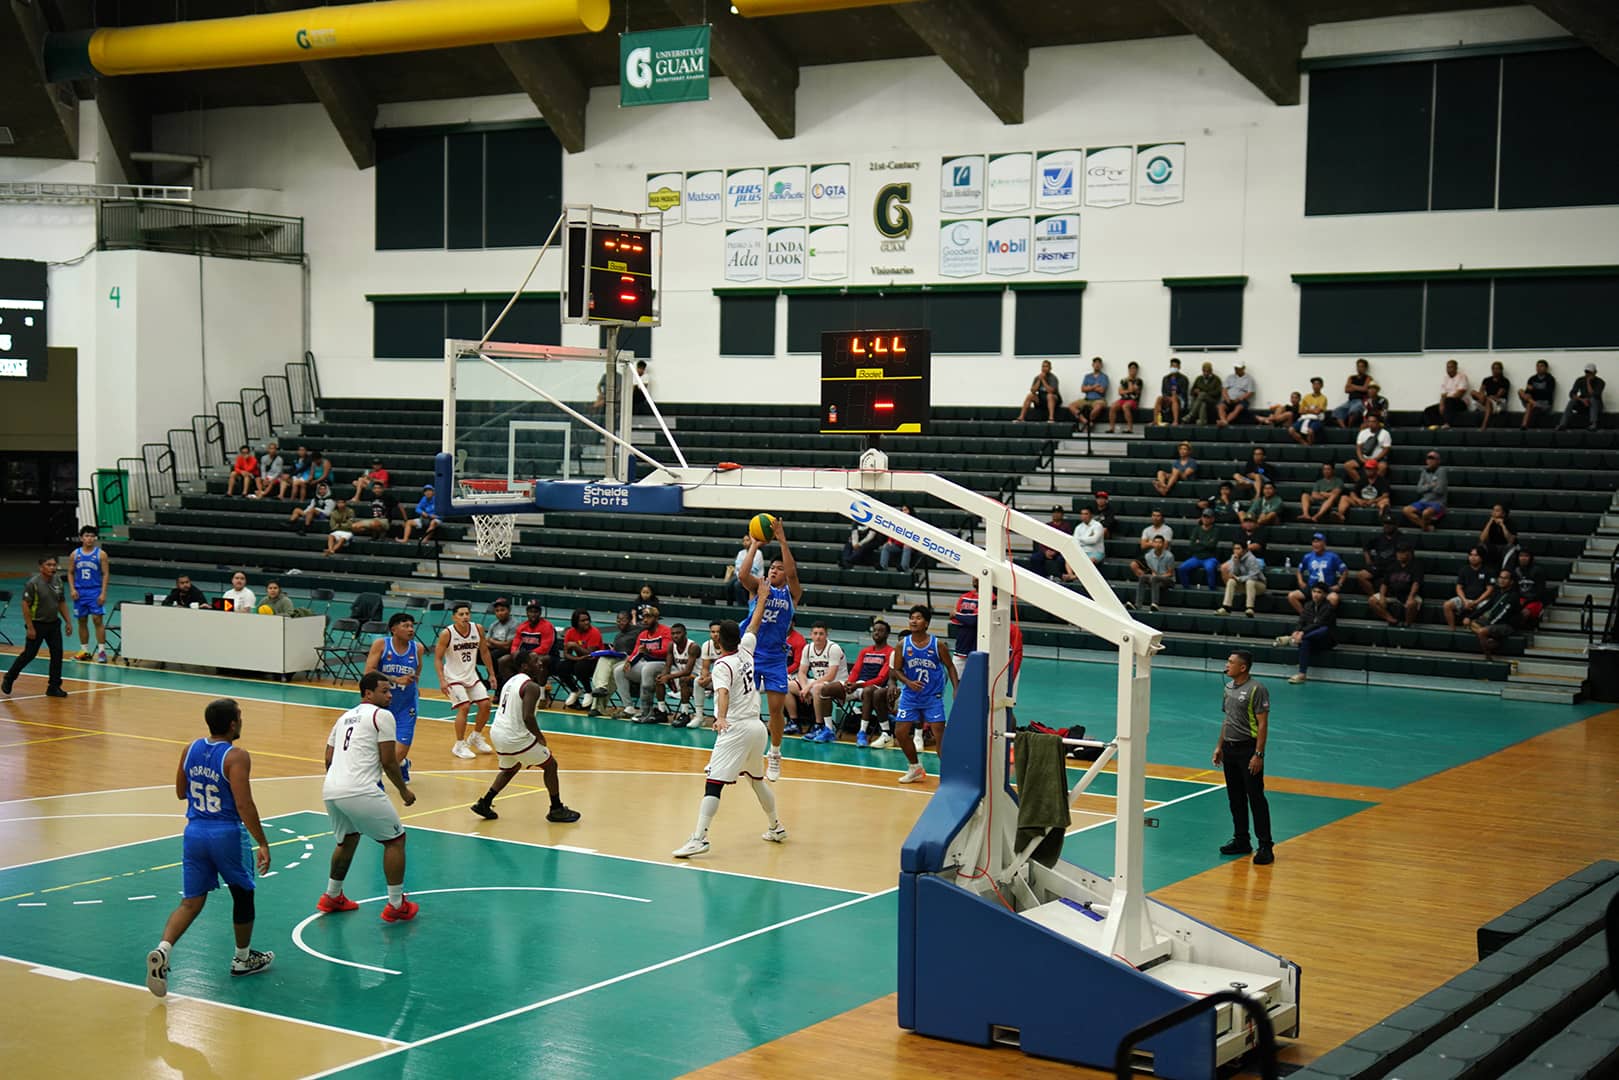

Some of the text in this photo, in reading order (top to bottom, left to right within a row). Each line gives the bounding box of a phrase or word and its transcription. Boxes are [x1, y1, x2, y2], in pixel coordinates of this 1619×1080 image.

[656, 49, 693, 58] UNIVERSITY
[656, 56, 704, 75] GUAM
[687, 192, 720, 200] Matson
[825, 185, 846, 196] GTA
[768, 242, 804, 252] LINDA
[988, 240, 1026, 253] Mobil
[728, 249, 759, 266] Ada
[769, 254, 802, 264] LOOK
[871, 267, 914, 275] Visionaries
[109, 286, 120, 308] 4
[583, 485, 629, 497] Schelde
[583, 494, 629, 507] Sports
[874, 514, 920, 543] Schelde
[921, 536, 961, 562] Sports
[81, 568, 91, 579] 15
[461, 652, 472, 663] 26
[343, 726, 354, 752] 8
[190, 780, 222, 814] 56
